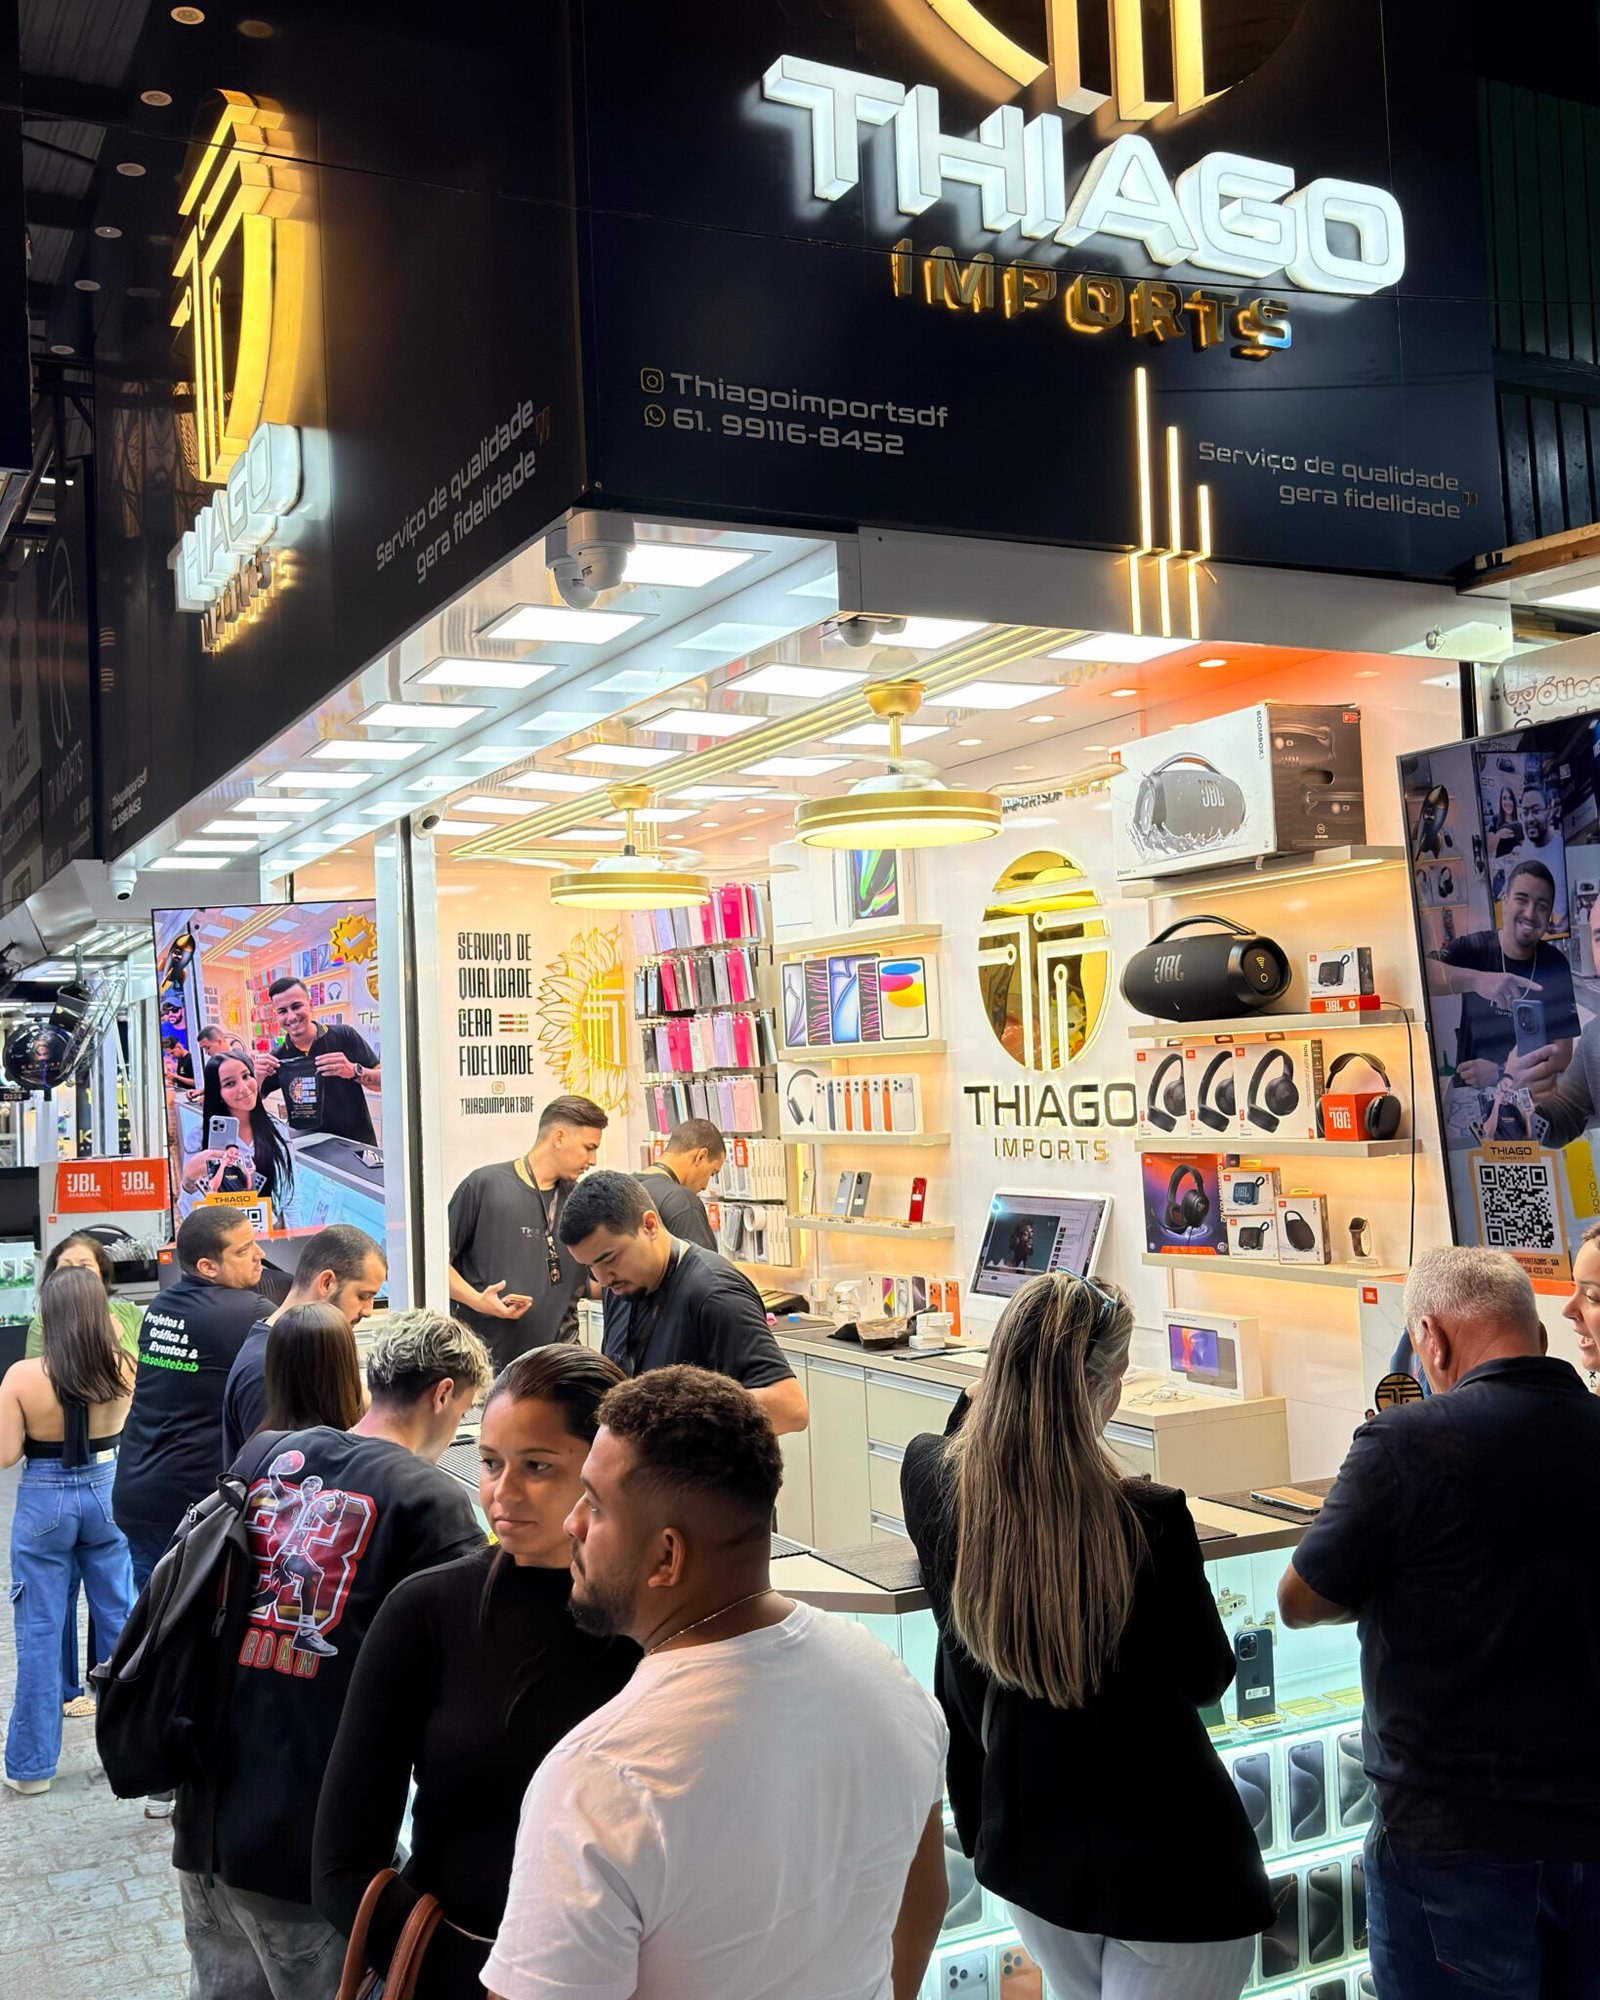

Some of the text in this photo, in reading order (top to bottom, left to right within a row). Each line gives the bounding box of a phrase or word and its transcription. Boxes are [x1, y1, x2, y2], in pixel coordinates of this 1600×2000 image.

[761, 55, 1406, 294] THIAGO
[892, 238, 1293, 360] IMPORTS
[670, 372, 948, 427] Thiagoimportsdf
[673, 408, 905, 455] 61. 99116-8452
[1199, 442, 1459, 491] Serviço de qualidade
[376, 400, 534, 571] Serviço de qualidade
[416, 450, 536, 584] gera fidelidade
[1279, 484, 1461, 519] gera fidelidade
[1256, 710, 1265, 756] BOOMBOX
[1198, 779, 1225, 807] JBL
[458, 932, 532, 964] SERVIÇO DE
[458, 967, 533, 1000] QUALIDADE
[1154, 954, 1185, 984] JBL
[1325, 1000, 1343, 1012] JBL
[458, 1008, 493, 1037] GERA
[459, 1045, 534, 1076] FIDELIDADE
[964, 1083, 1138, 1127] THIAGO
[1329, 1111, 1351, 1128] JBL
[994, 1137, 1109, 1161] IMPORTS
[1490, 1146, 1532, 1156] THIAGO
[67, 1173, 101, 1192] JBL
[121, 1171, 155, 1190] JBL
[1234, 1186, 1250, 1198] JBL
[145, 1312, 185, 1330] Projetos &
[150, 1327, 189, 1344] Gráfica &
[149, 1341, 199, 1359] Eventos &
[238, 1627, 321, 1680] RDAN
